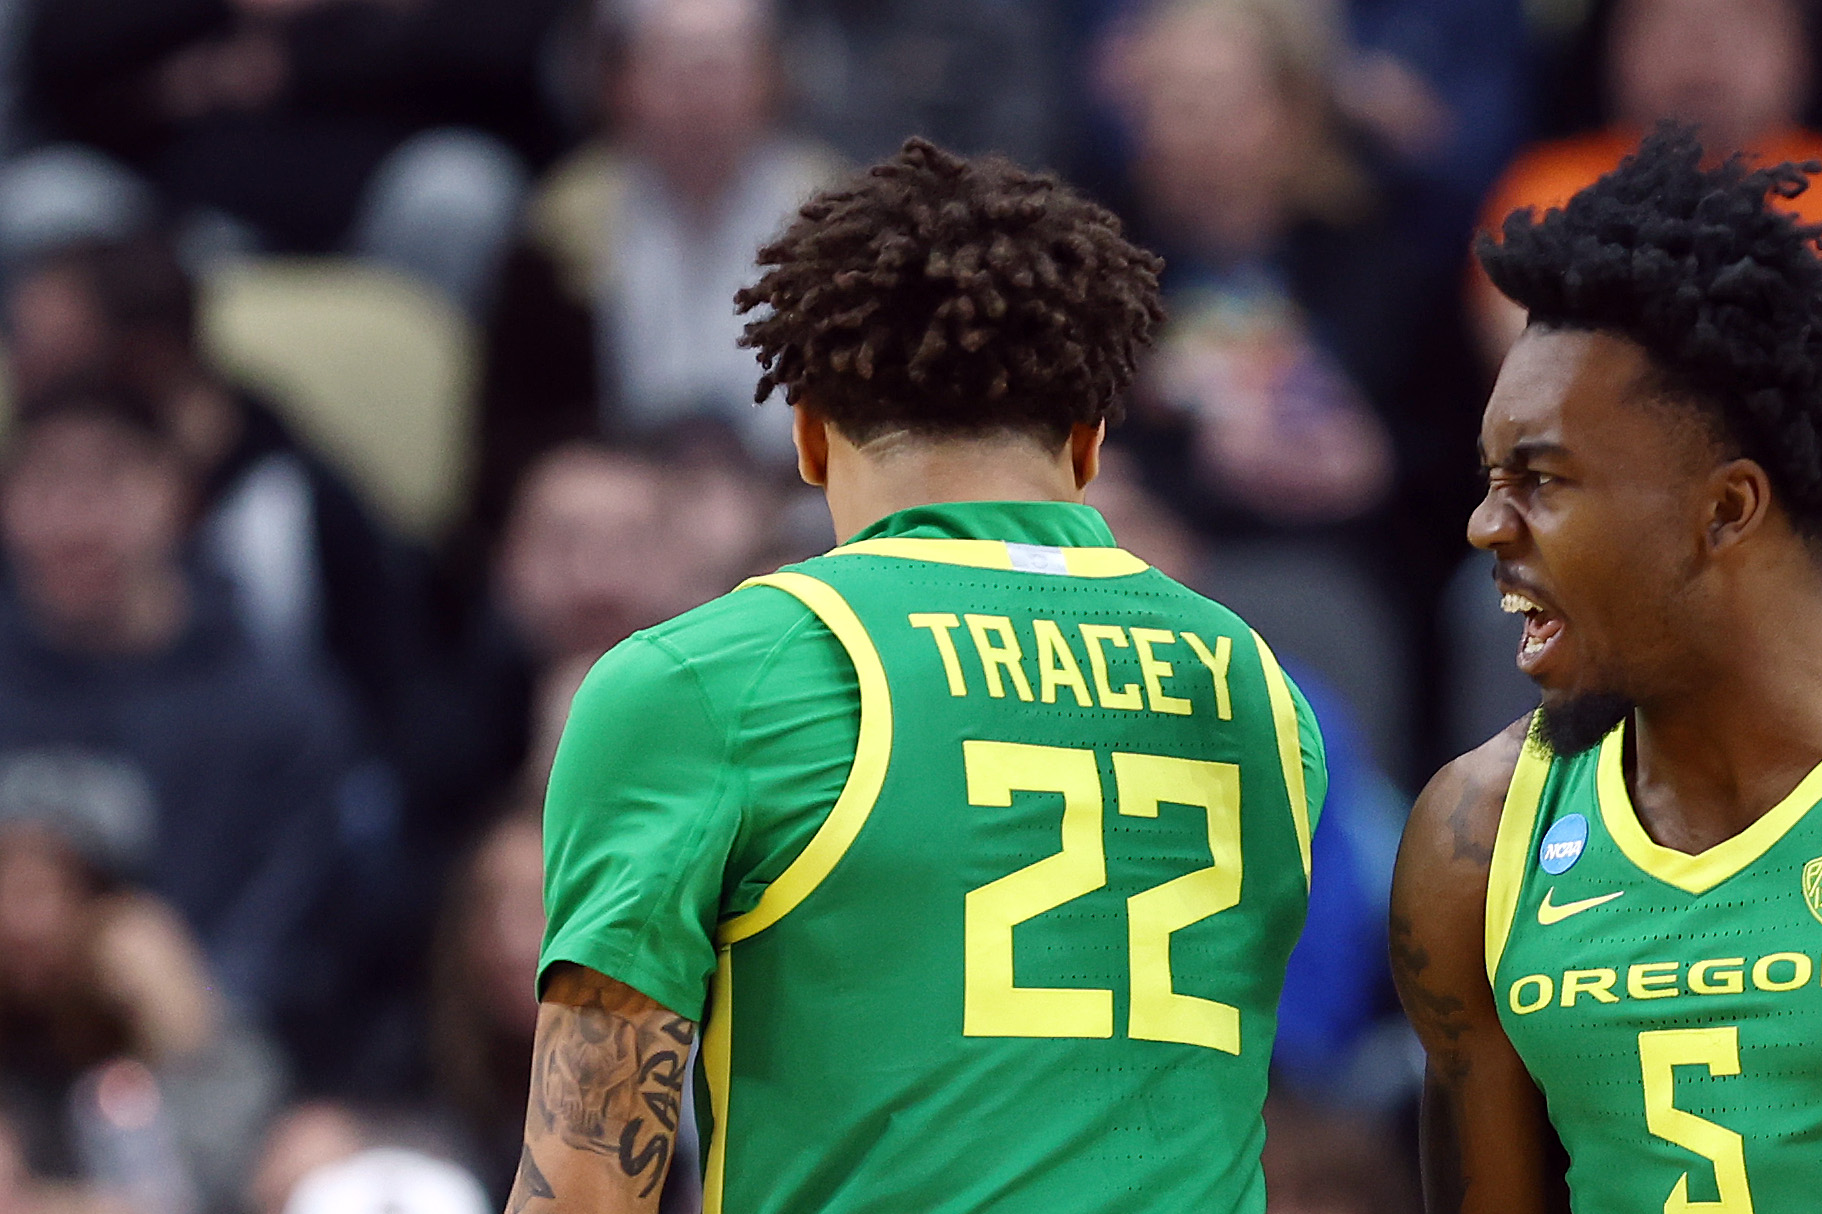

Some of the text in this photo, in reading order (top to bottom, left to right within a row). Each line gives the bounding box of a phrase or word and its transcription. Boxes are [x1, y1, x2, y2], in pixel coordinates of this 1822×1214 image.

[908, 612, 1232, 721] TRACEY
[962, 740, 1241, 1056] 22
[1543, 840, 1583, 861] NCAA
